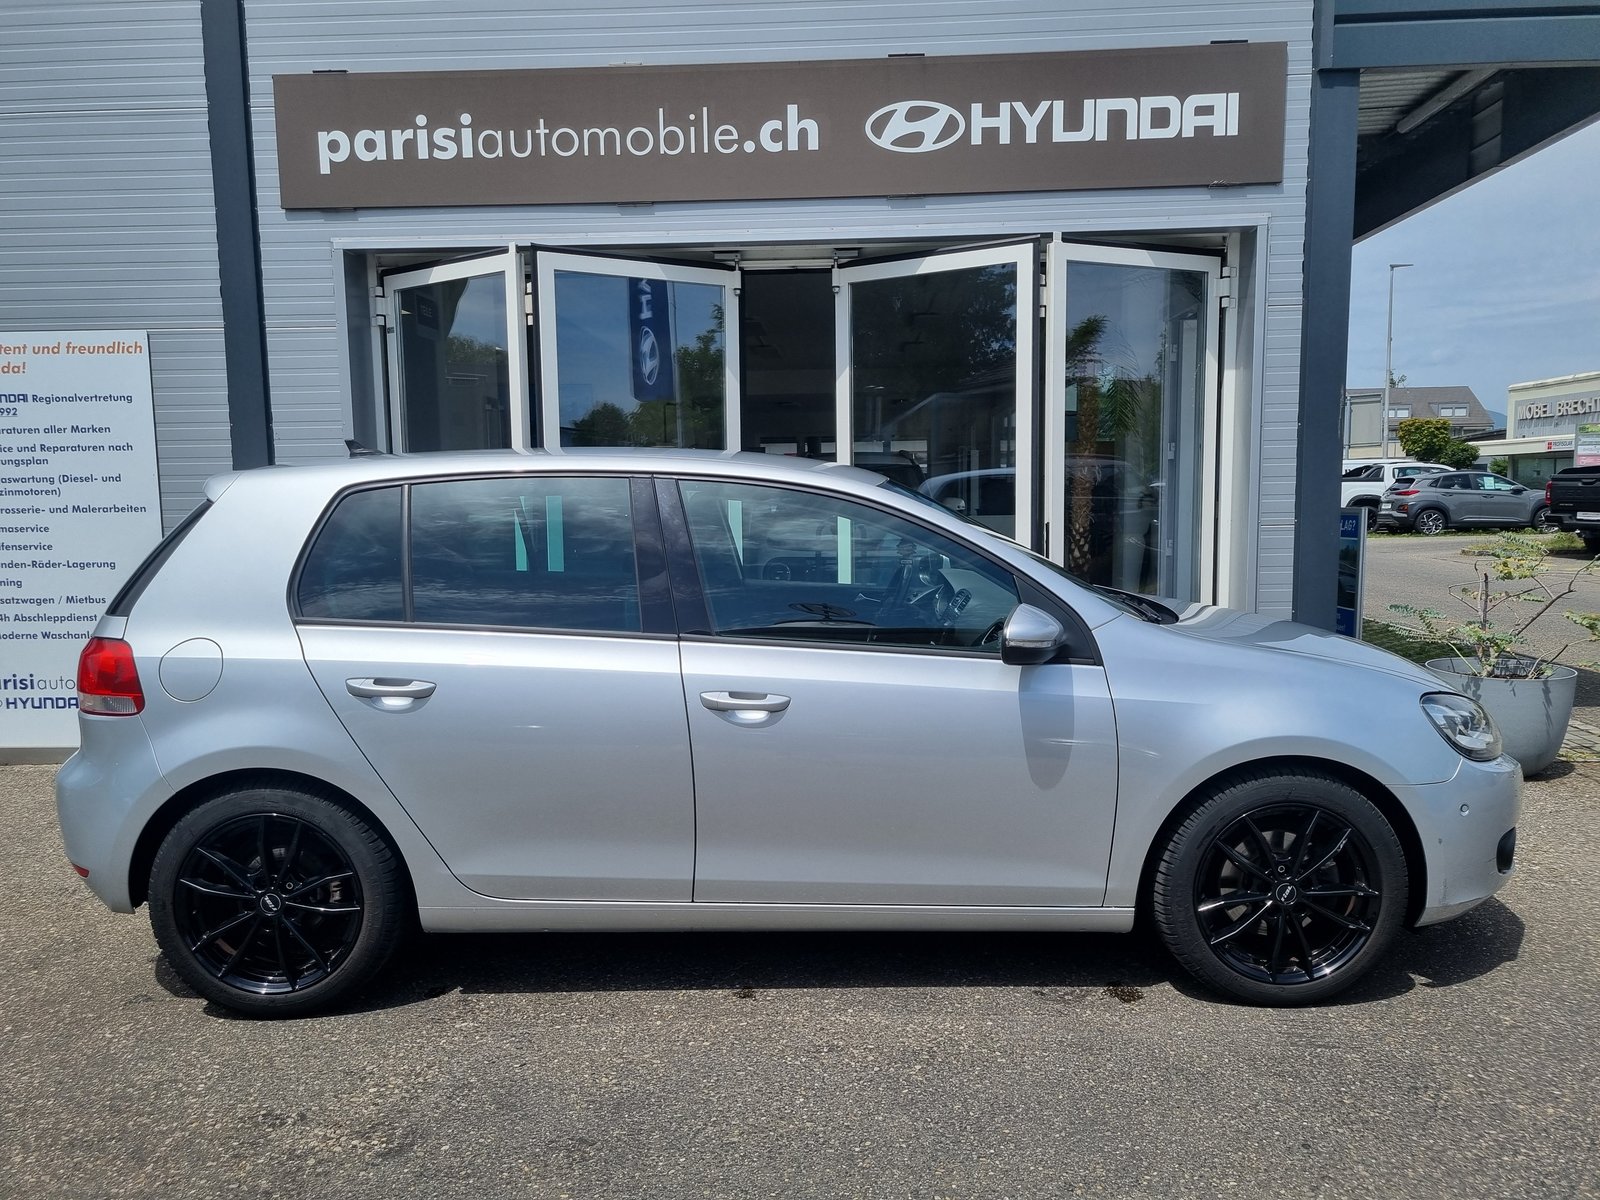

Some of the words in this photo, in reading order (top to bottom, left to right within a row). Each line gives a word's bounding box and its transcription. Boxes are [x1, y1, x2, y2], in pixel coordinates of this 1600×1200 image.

[971, 92, 1240, 146] HYUNDAI
[317, 104, 819, 174] parisiautomobile.ch
[32, 341, 61, 355] und
[65, 341, 143, 354] freundlich
[1, 361, 26, 374] da!
[32, 393, 133, 404] Regionalvertretung
[1518, 402, 1554, 420] MÖBEL
[0, 425, 40, 435] raturen
[43, 424, 67, 434] aller
[70, 424, 111, 434] Marken
[17, 443, 36, 453] und
[40, 443, 105, 454] Reparaturen
[108, 442, 133, 452] nach
[1, 456, 49, 467] ungsplan
[1, 475, 55, 485] aswartung
[58, 474, 98, 485] (Diesel-
[101, 473, 122, 483] und
[0, 487, 61, 497] zinmotoren)
[0, 505, 46, 515] rosserie-
[49, 504, 69, 514] und
[72, 504, 147, 514] Malerarbeiten
[0, 542, 53, 551] fenservice
[1, 559, 116, 570] nden-Räder-Lagerung
[0, 596, 55, 606] satzwagen
[66, 595, 106, 604] Mietbus
[13, 613, 98, 624] Abschleppdienst
[0, 631, 38, 640] oderne
[41, 630, 93, 640] Waschanl
[0, 673, 76, 690] risiauto
